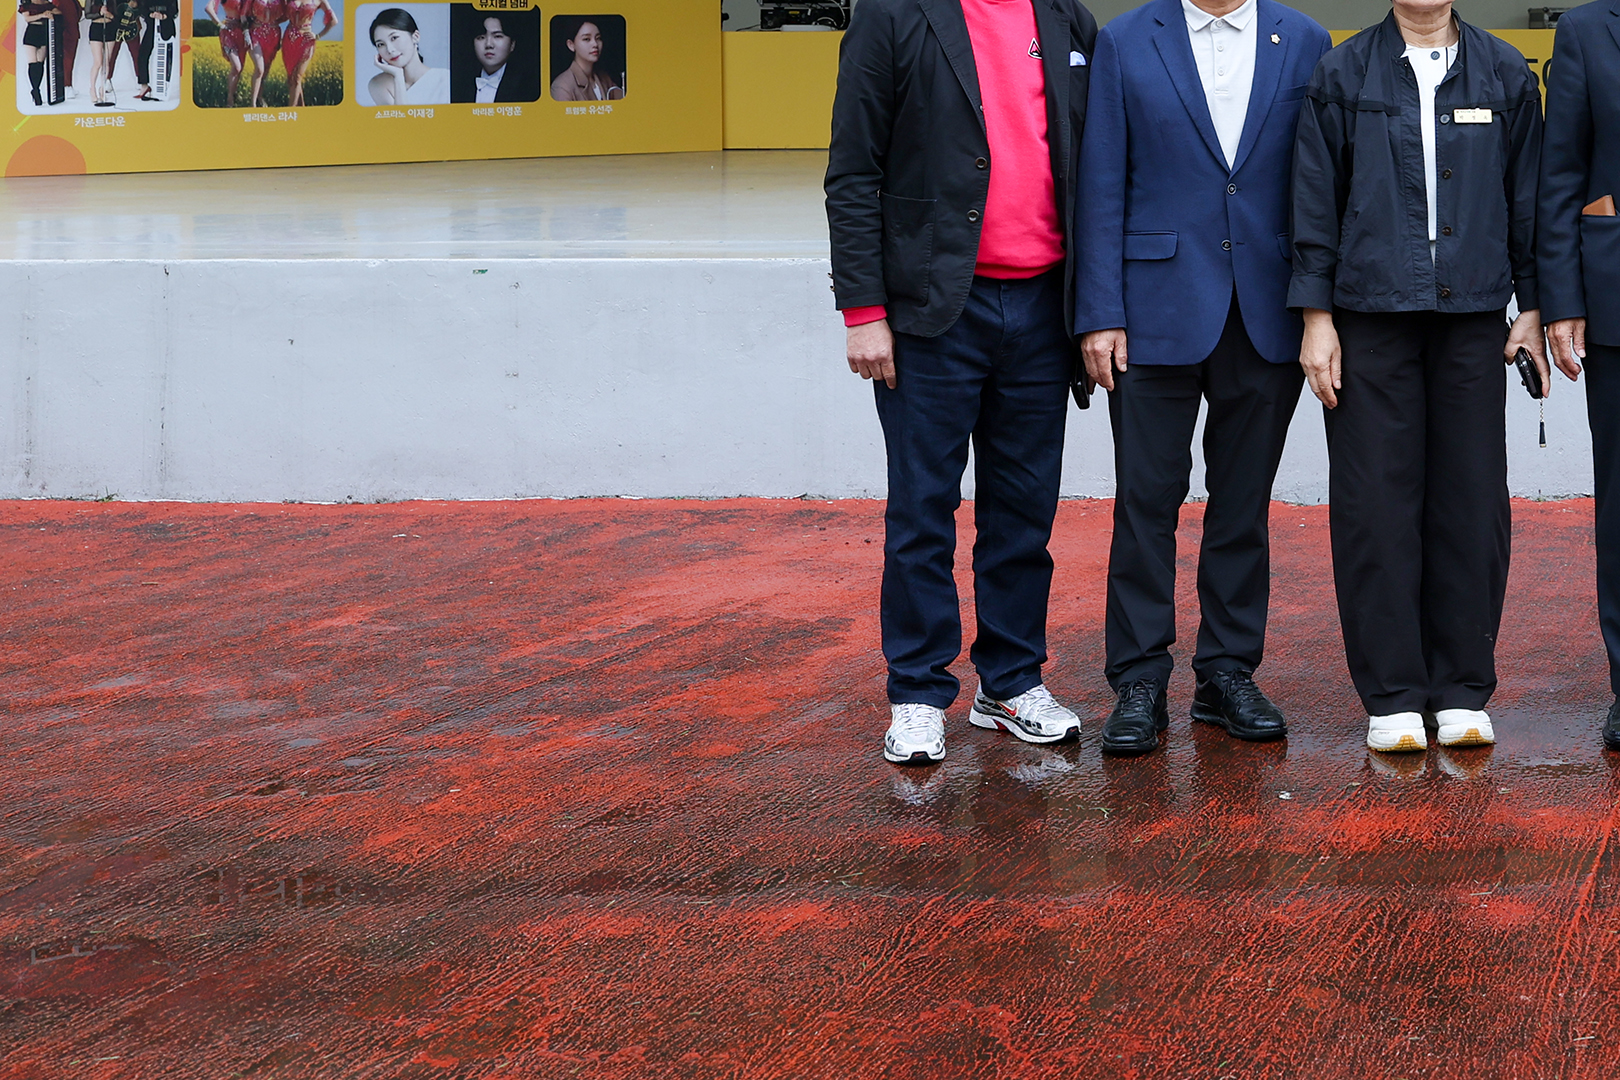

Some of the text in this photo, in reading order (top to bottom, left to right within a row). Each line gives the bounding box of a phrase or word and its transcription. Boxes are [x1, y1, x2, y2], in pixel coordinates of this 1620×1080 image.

[510, 0, 528, 8] 넘버
[374, 110, 406, 118] 소프라노
[74, 116, 126, 128] 카운트다운
